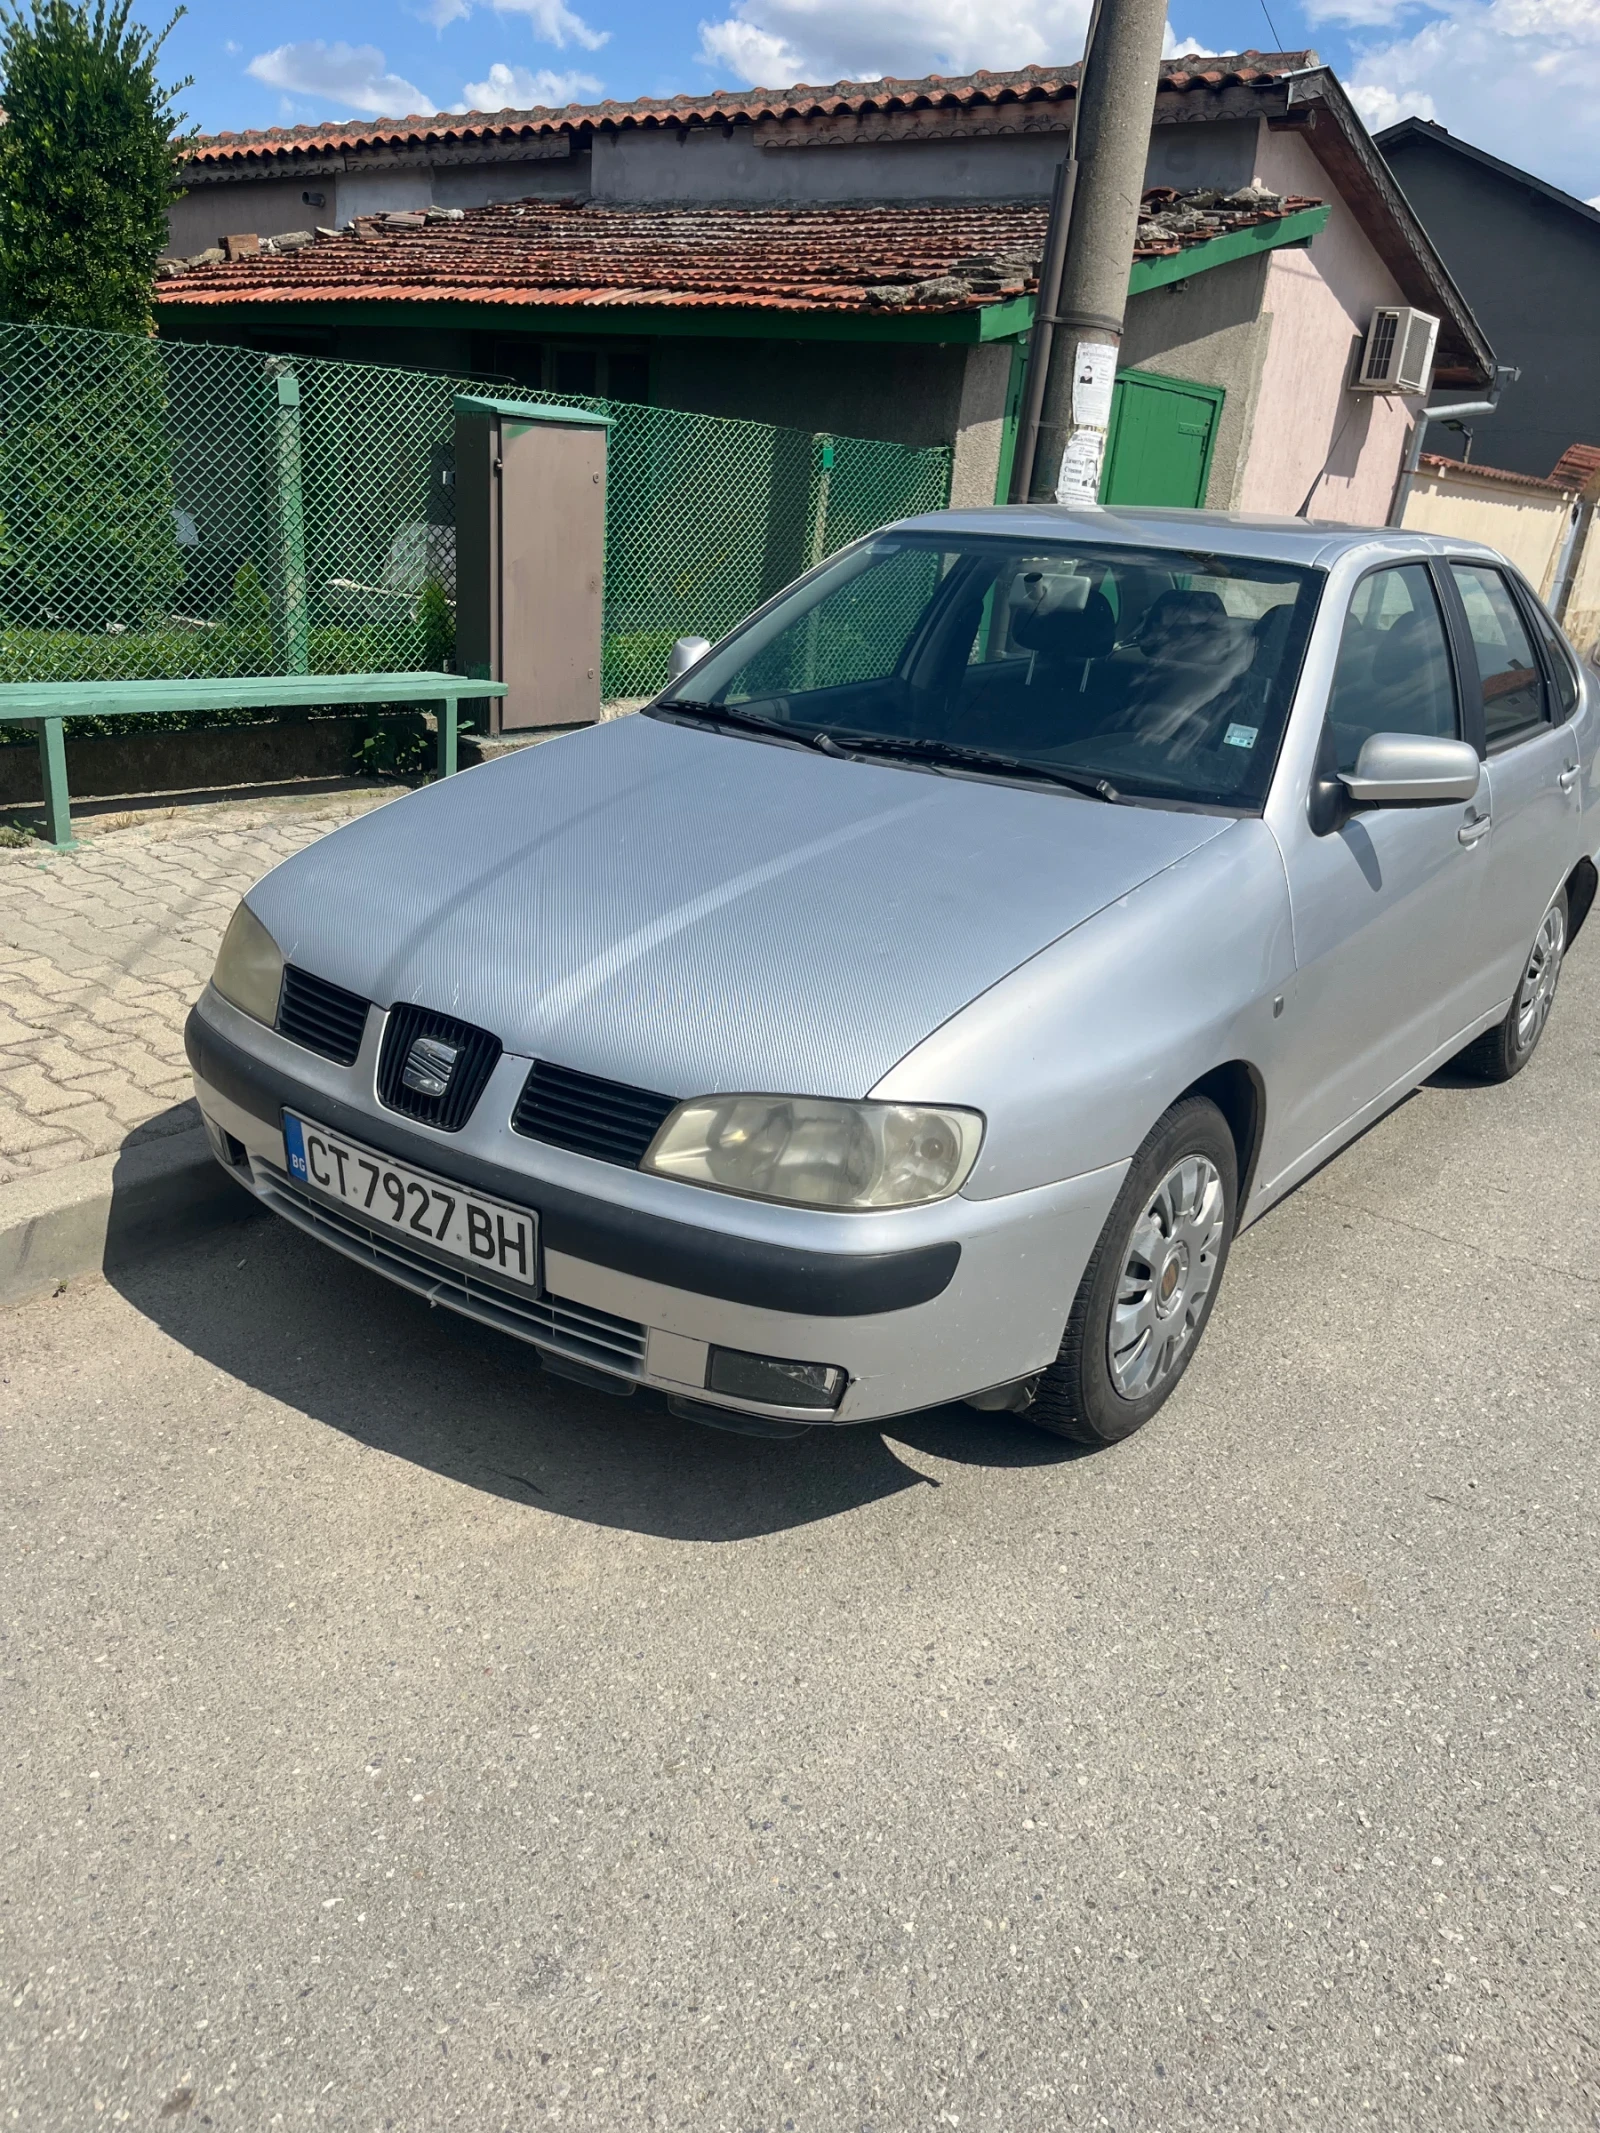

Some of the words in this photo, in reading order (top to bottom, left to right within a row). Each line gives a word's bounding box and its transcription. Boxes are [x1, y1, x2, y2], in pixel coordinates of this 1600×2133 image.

[291, 1153, 306, 1173] BG
[307, 1135, 350, 1197] CT
[357, 1158, 456, 1242] 7927
[466, 1202, 527, 1276] BH
